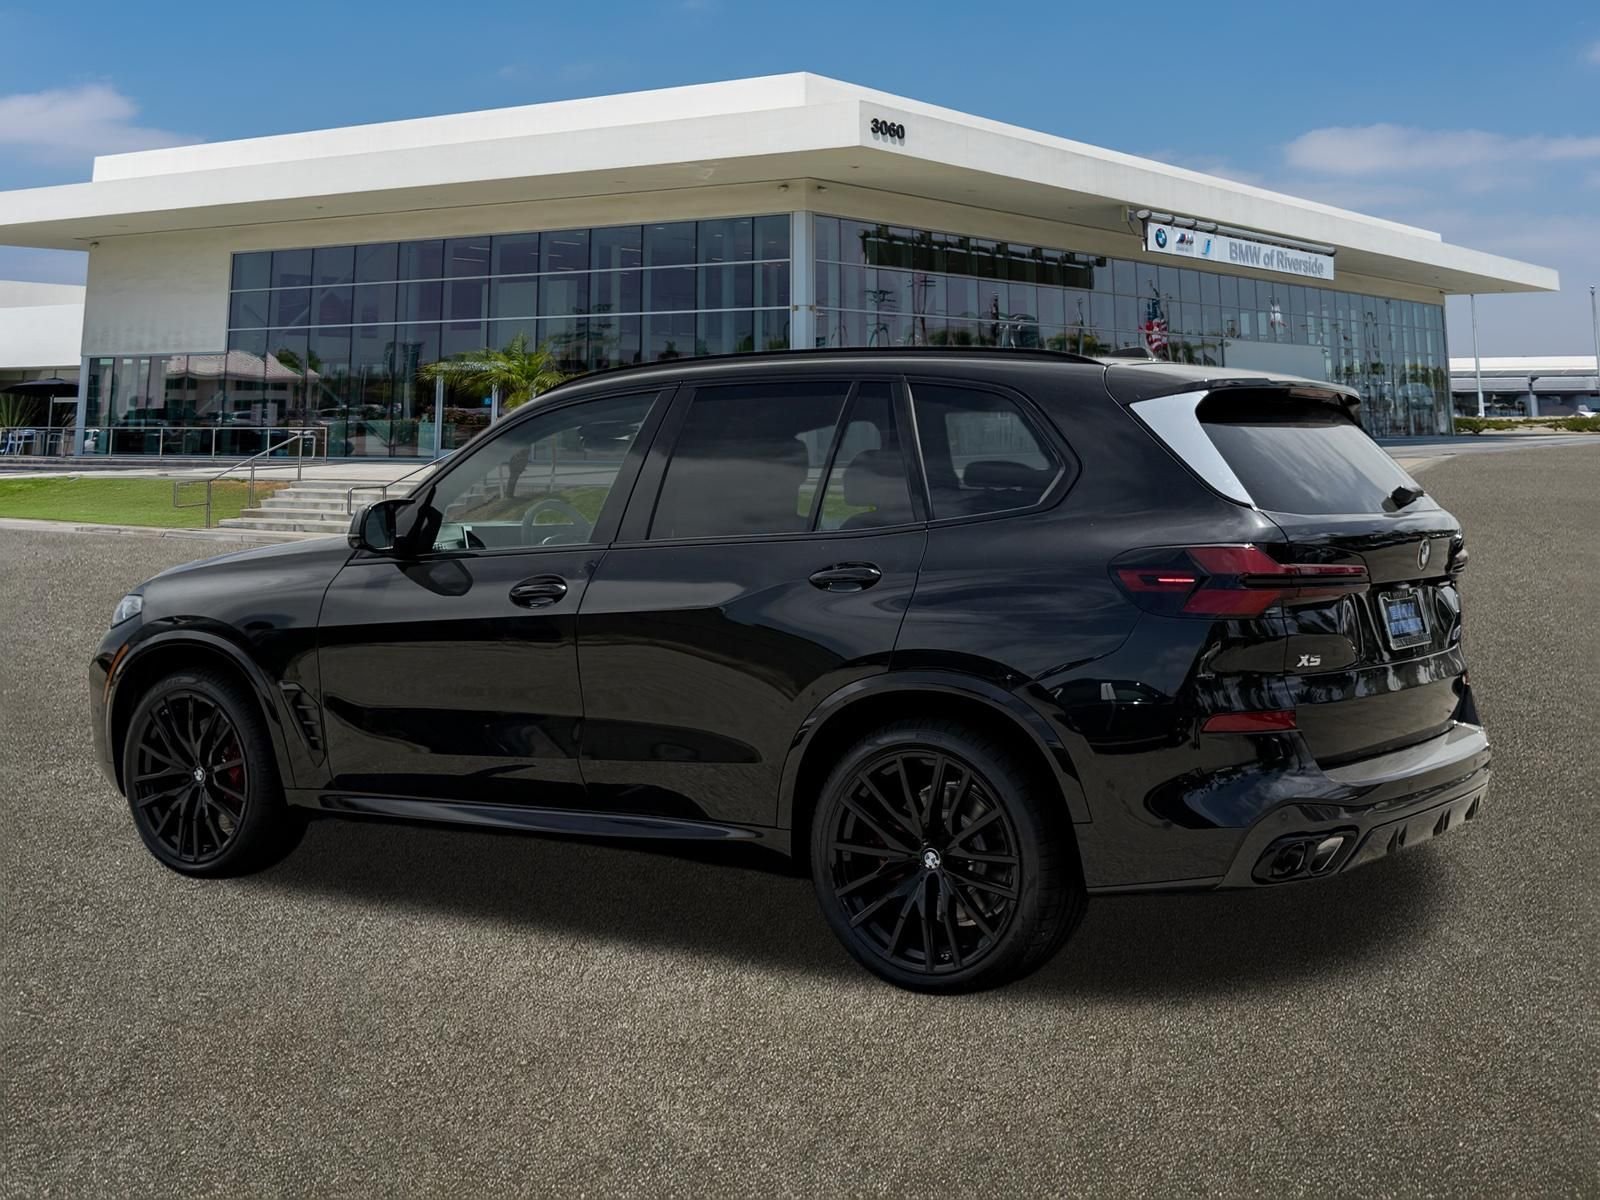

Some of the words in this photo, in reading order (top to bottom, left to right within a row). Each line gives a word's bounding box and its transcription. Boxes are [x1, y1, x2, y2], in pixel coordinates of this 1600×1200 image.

[871, 118, 905, 139] 3060
[1229, 241, 1261, 265] BMW
[1263, 249, 1275, 268] of
[1276, 250, 1324, 275] Riverside
[1296, 654, 1321, 667] X5
